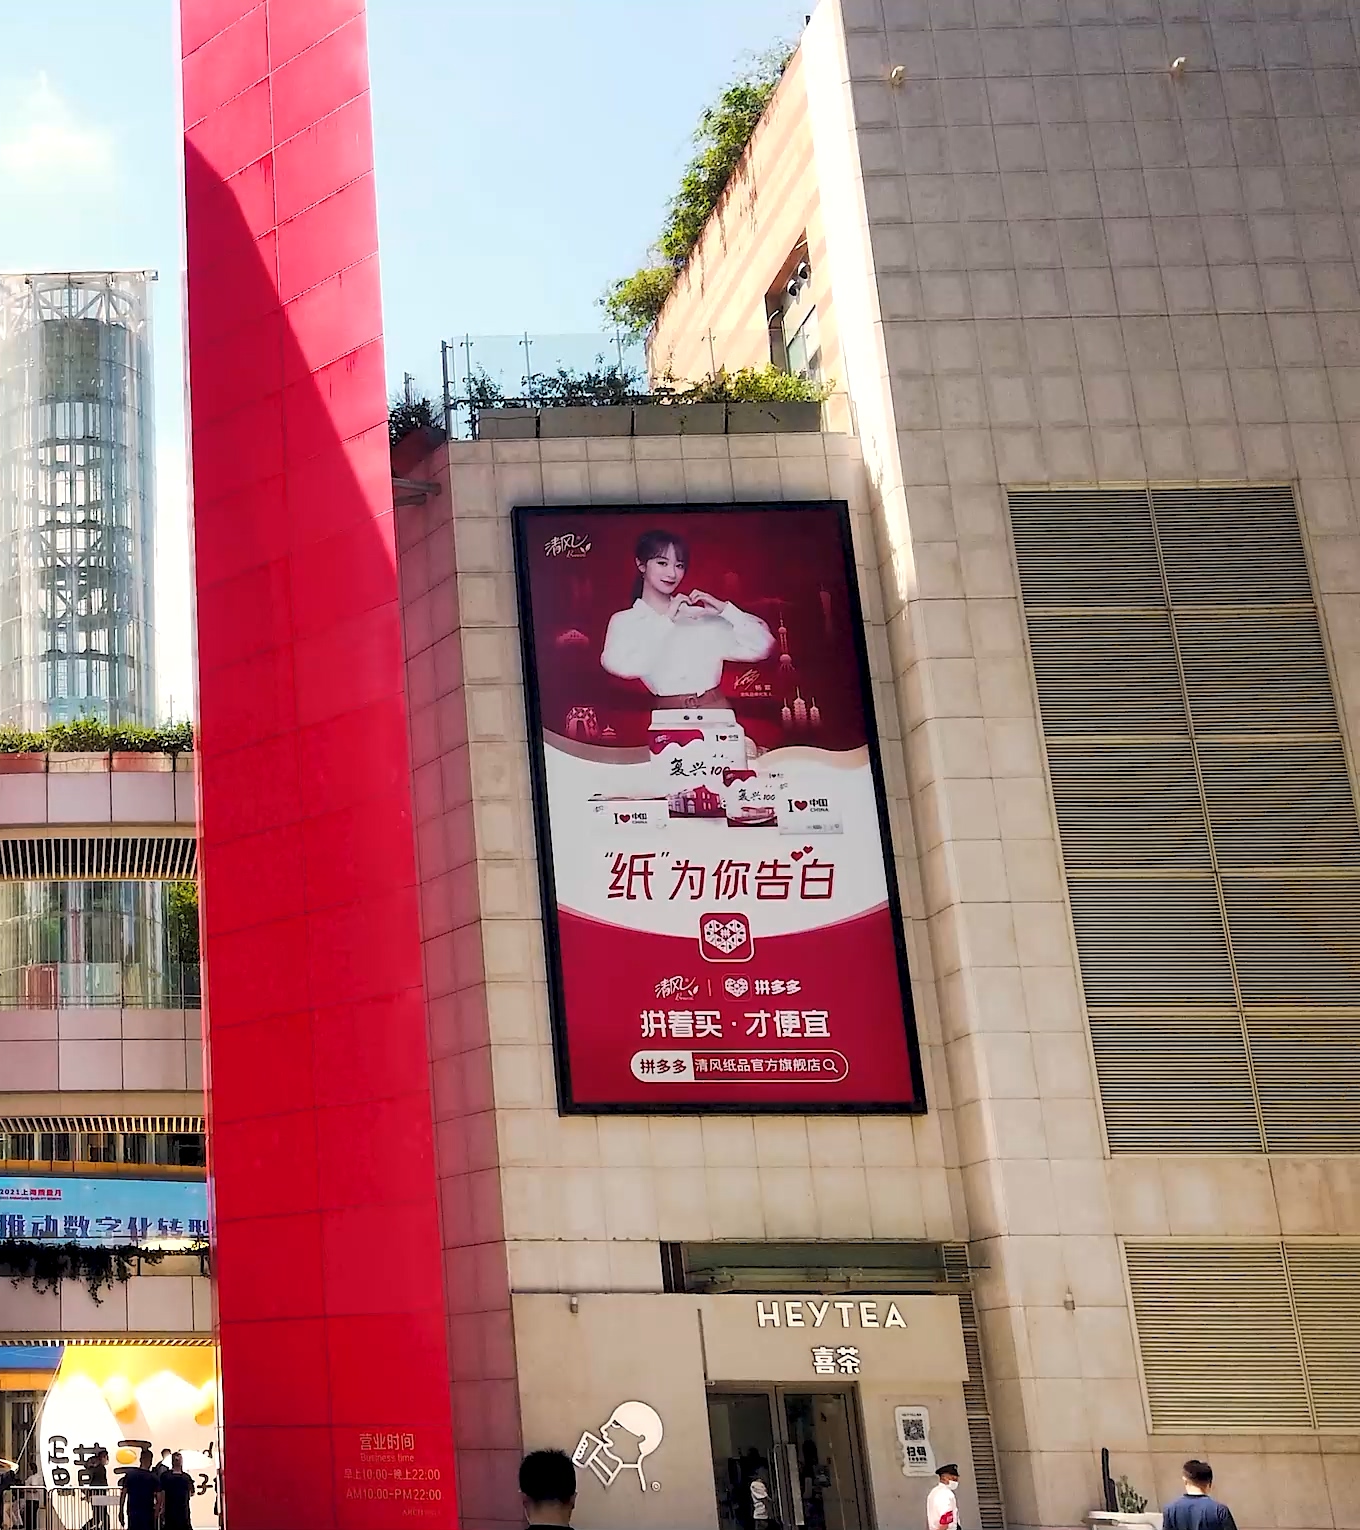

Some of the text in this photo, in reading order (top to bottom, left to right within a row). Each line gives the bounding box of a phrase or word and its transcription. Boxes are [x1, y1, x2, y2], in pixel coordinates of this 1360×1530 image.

[654, 975, 802, 999] 清风 拼多多
[640, 1058, 821, 1075] 拼多多 清风纸品官方旗舰店
[756, 1301, 907, 1328] HEYTEA
[812, 1346, 861, 1375] 喜茶
[359, 1433, 415, 1451] 营业时间
[360, 1453, 415, 1463] Business time
